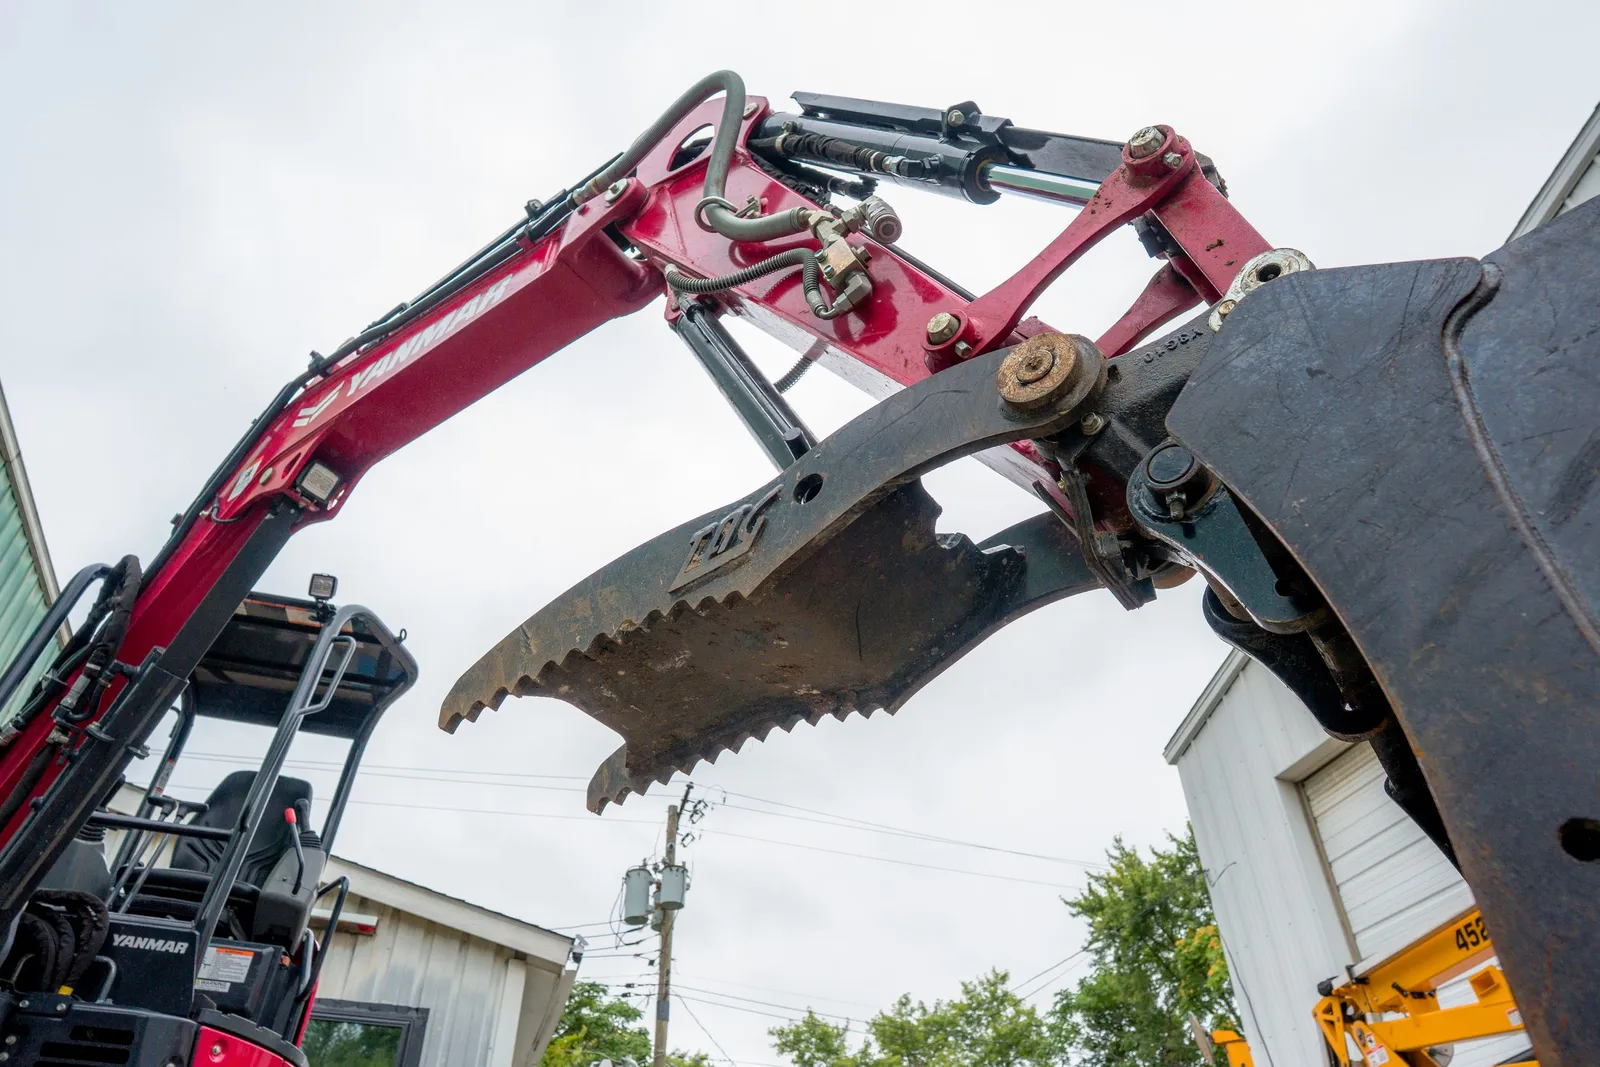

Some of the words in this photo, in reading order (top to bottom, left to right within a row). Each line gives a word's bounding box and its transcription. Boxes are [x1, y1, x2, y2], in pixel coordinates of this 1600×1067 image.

[347, 273, 513, 397] YANMAR
[112, 933, 189, 955] YANMAR
[1456, 916, 1489, 951] 452
